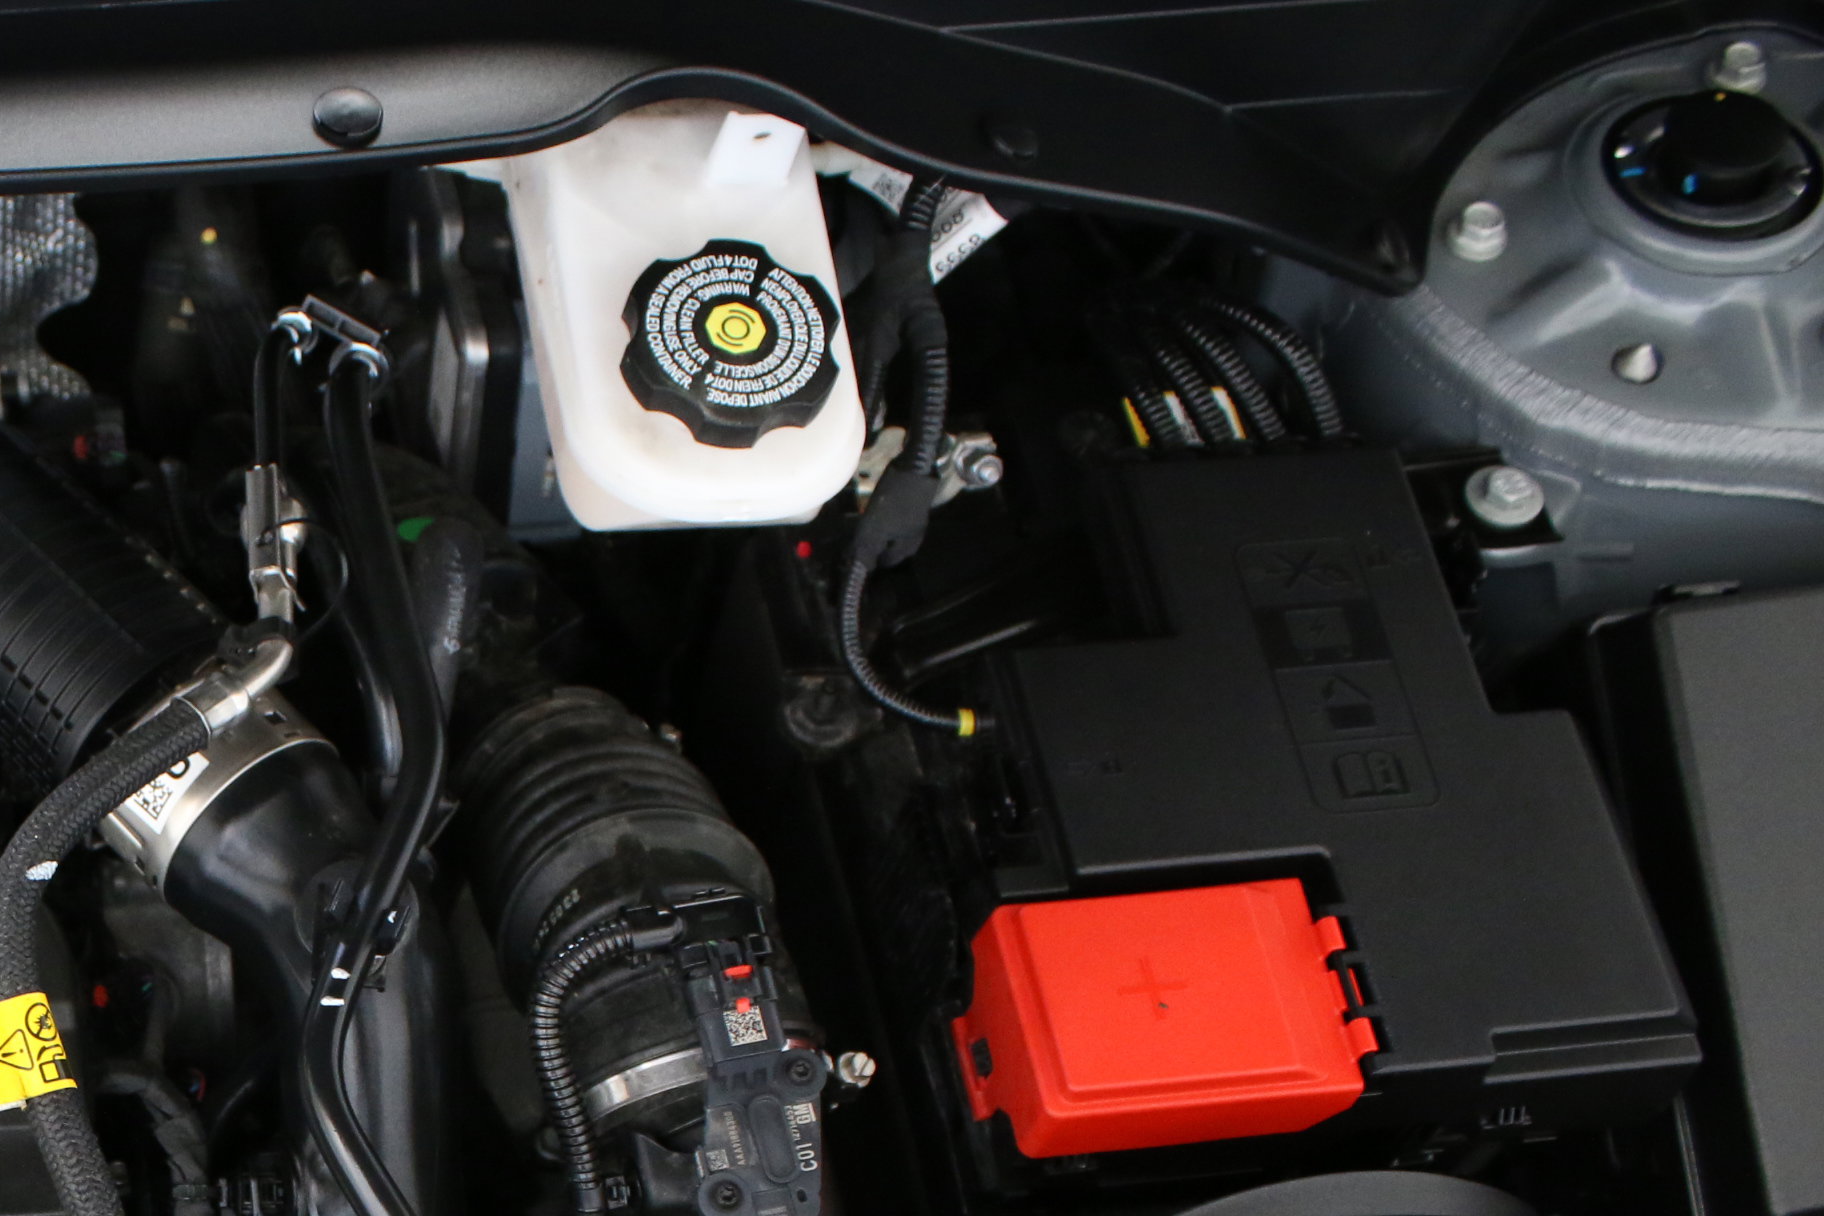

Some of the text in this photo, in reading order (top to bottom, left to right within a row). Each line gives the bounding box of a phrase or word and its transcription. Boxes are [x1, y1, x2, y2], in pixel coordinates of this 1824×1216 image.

[690, 255, 724, 272] FLUID
[724, 255, 733, 267] 4
[733, 256, 758, 269] DOT
[662, 264, 692, 288] FROM
[687, 268, 728, 289] BEFORE
[729, 269, 755, 283] CAP
[646, 292, 665, 331] SEALED
[756, 291, 791, 339] PROVENANT
[680, 282, 750, 365] WARNING: CLEAN FILLER
[793, 323, 808, 342] QUE
[805, 305, 825, 353] NETTOYER
[664, 332, 682, 352] USE
[792, 342, 807, 356] DU
[648, 334, 693, 390] CONTAINER.
[674, 349, 702, 377] ONLY
[807, 353, 822, 367] LE
[704, 373, 714, 385] 4
[711, 376, 733, 390] DOT
[733, 378, 763, 392] FREIN
[763, 375, 779, 389] DE
[780, 364, 818, 397] BOUCHON
[748, 388, 782, 407] AVANT
[793, 1103, 814, 1125] GM
